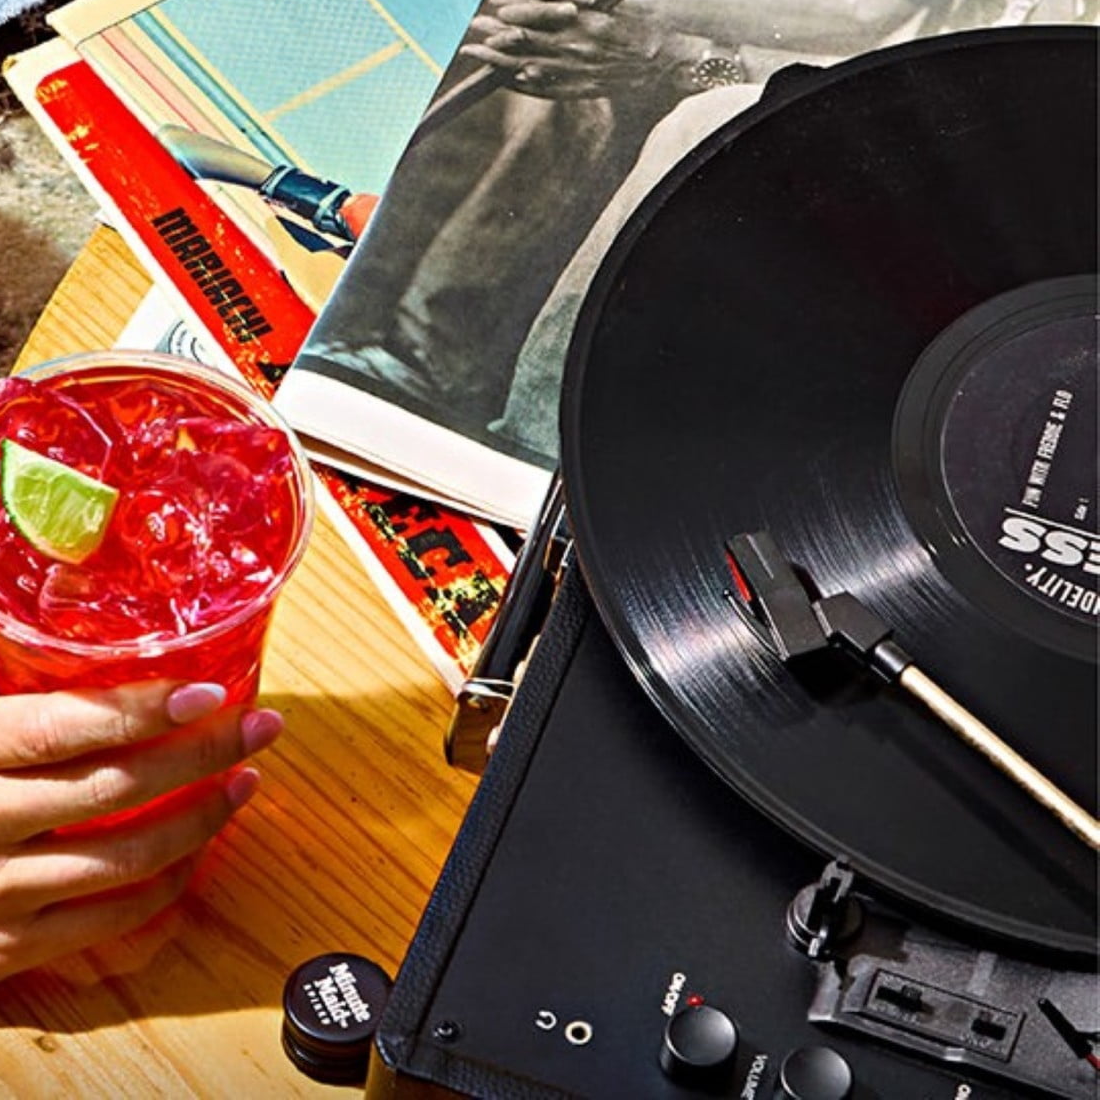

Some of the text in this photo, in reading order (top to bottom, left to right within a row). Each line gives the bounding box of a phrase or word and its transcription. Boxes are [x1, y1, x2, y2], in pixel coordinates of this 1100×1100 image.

[152, 206, 274, 344] MARIACHI
[1028, 458, 1051, 486] WITH
[312, 976, 351, 1022] Maid
[329, 962, 371, 1023] Minute
